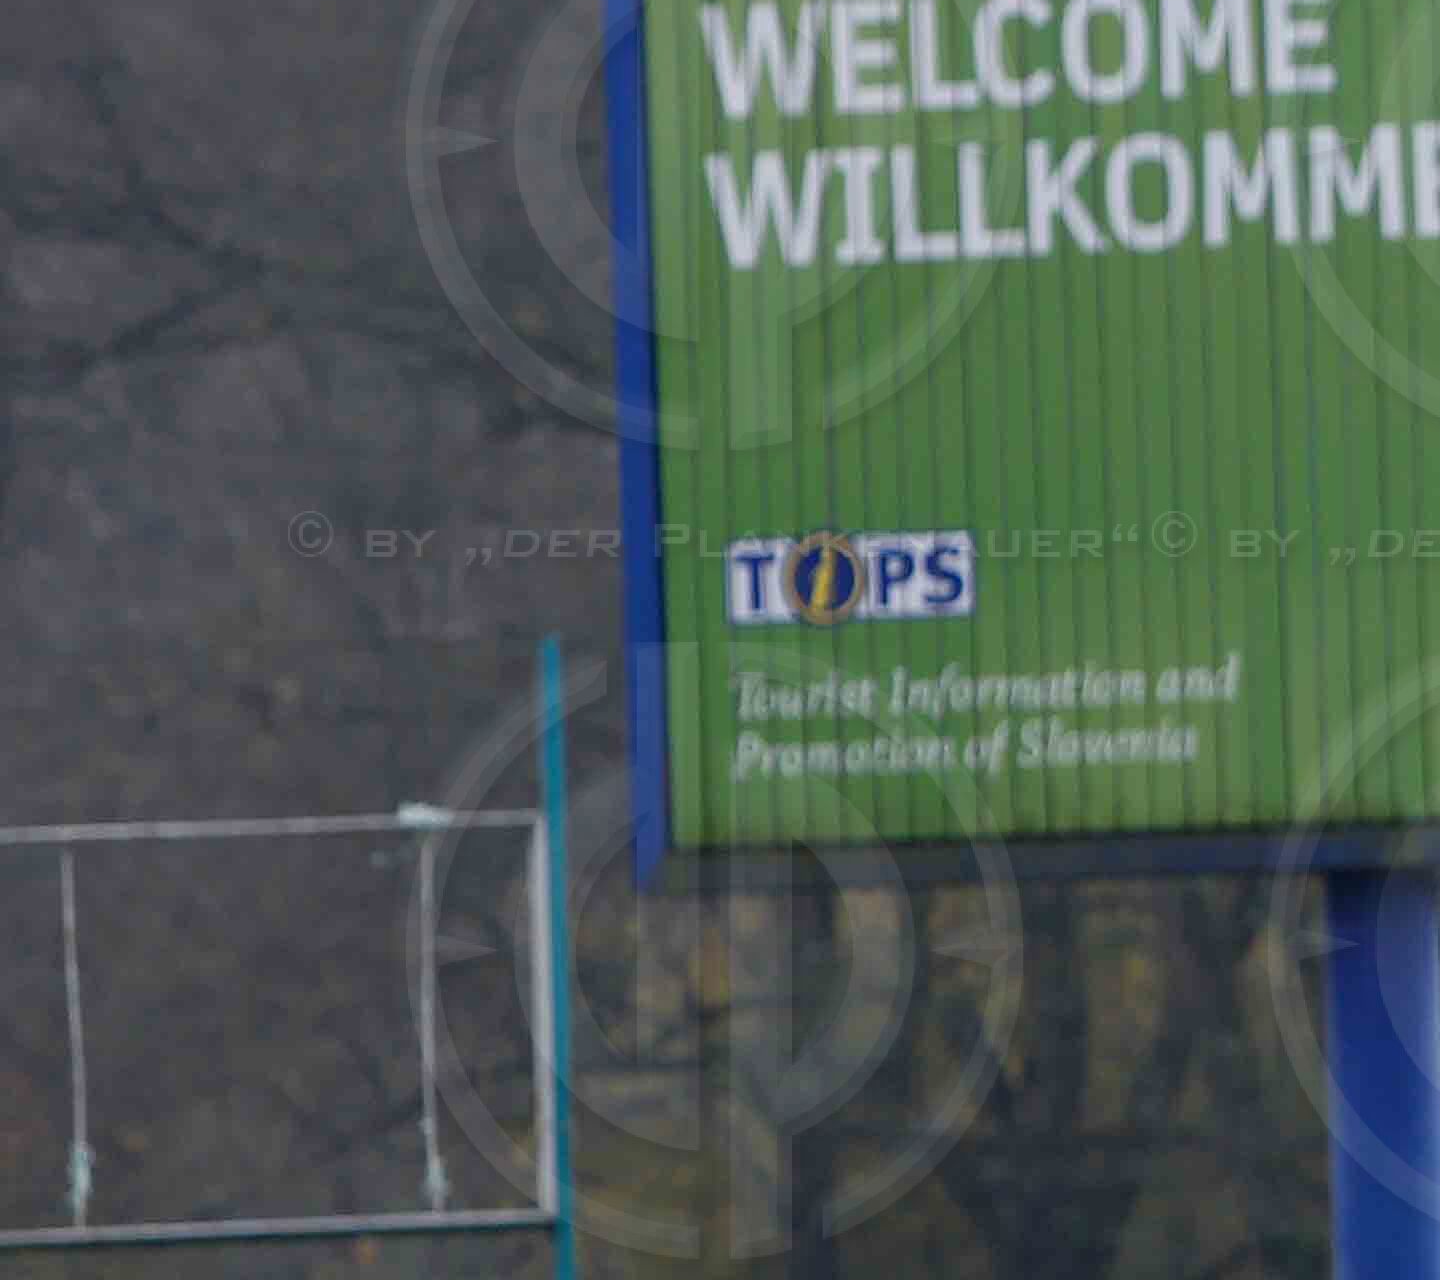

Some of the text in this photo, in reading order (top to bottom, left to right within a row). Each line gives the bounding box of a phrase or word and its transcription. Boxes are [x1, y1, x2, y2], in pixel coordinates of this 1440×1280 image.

[734, 651, 1243, 719] Tourist Information and
[732, 718, 1199, 784] Promotion of Slovenia
